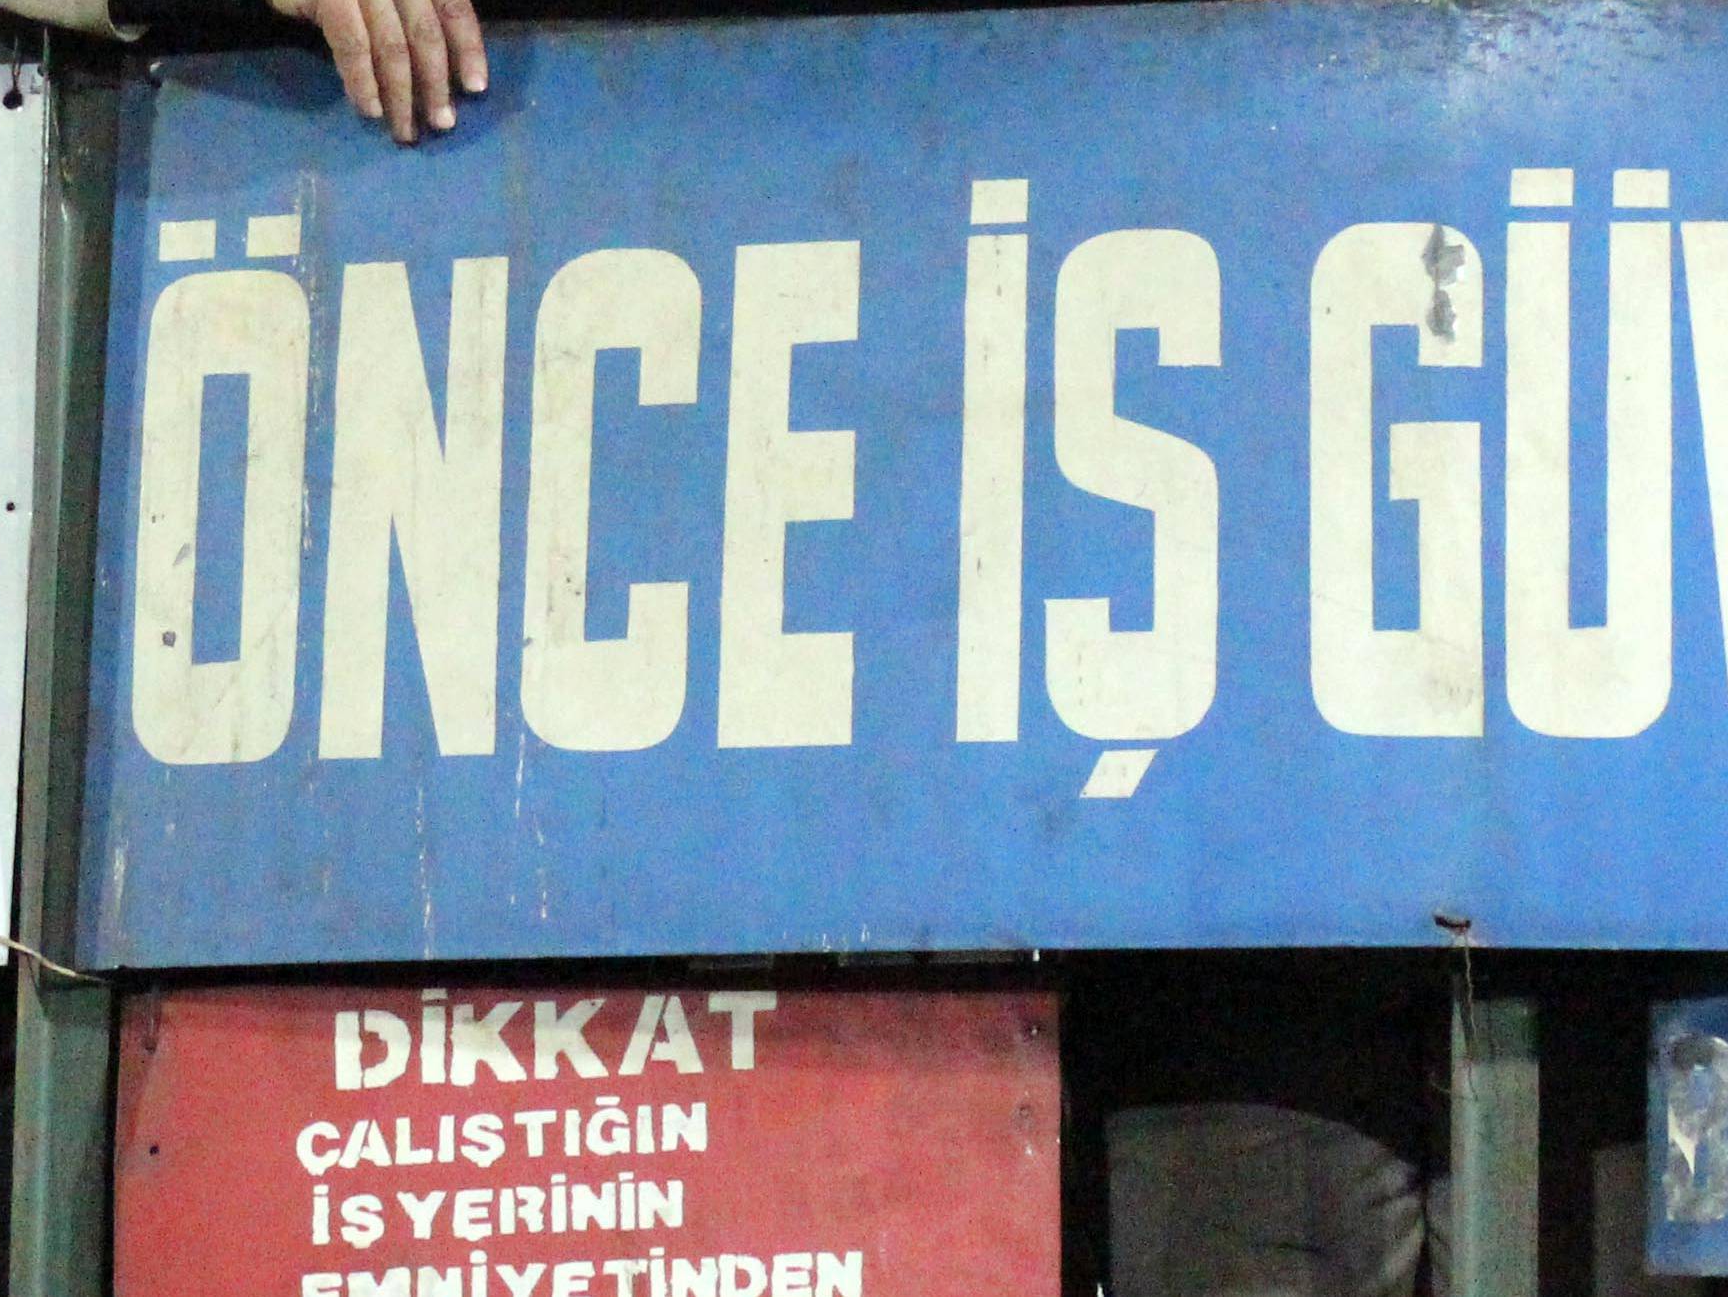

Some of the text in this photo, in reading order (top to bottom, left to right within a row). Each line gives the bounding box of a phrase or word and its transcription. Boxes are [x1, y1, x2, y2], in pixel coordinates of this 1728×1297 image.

[132, 212, 861, 766] ÖNCE
[955, 178, 1222, 799] İŞ
[334, 987, 778, 1091] DİKKAT
[296, 1095, 709, 1176] ÇALIŞTIĞIN
